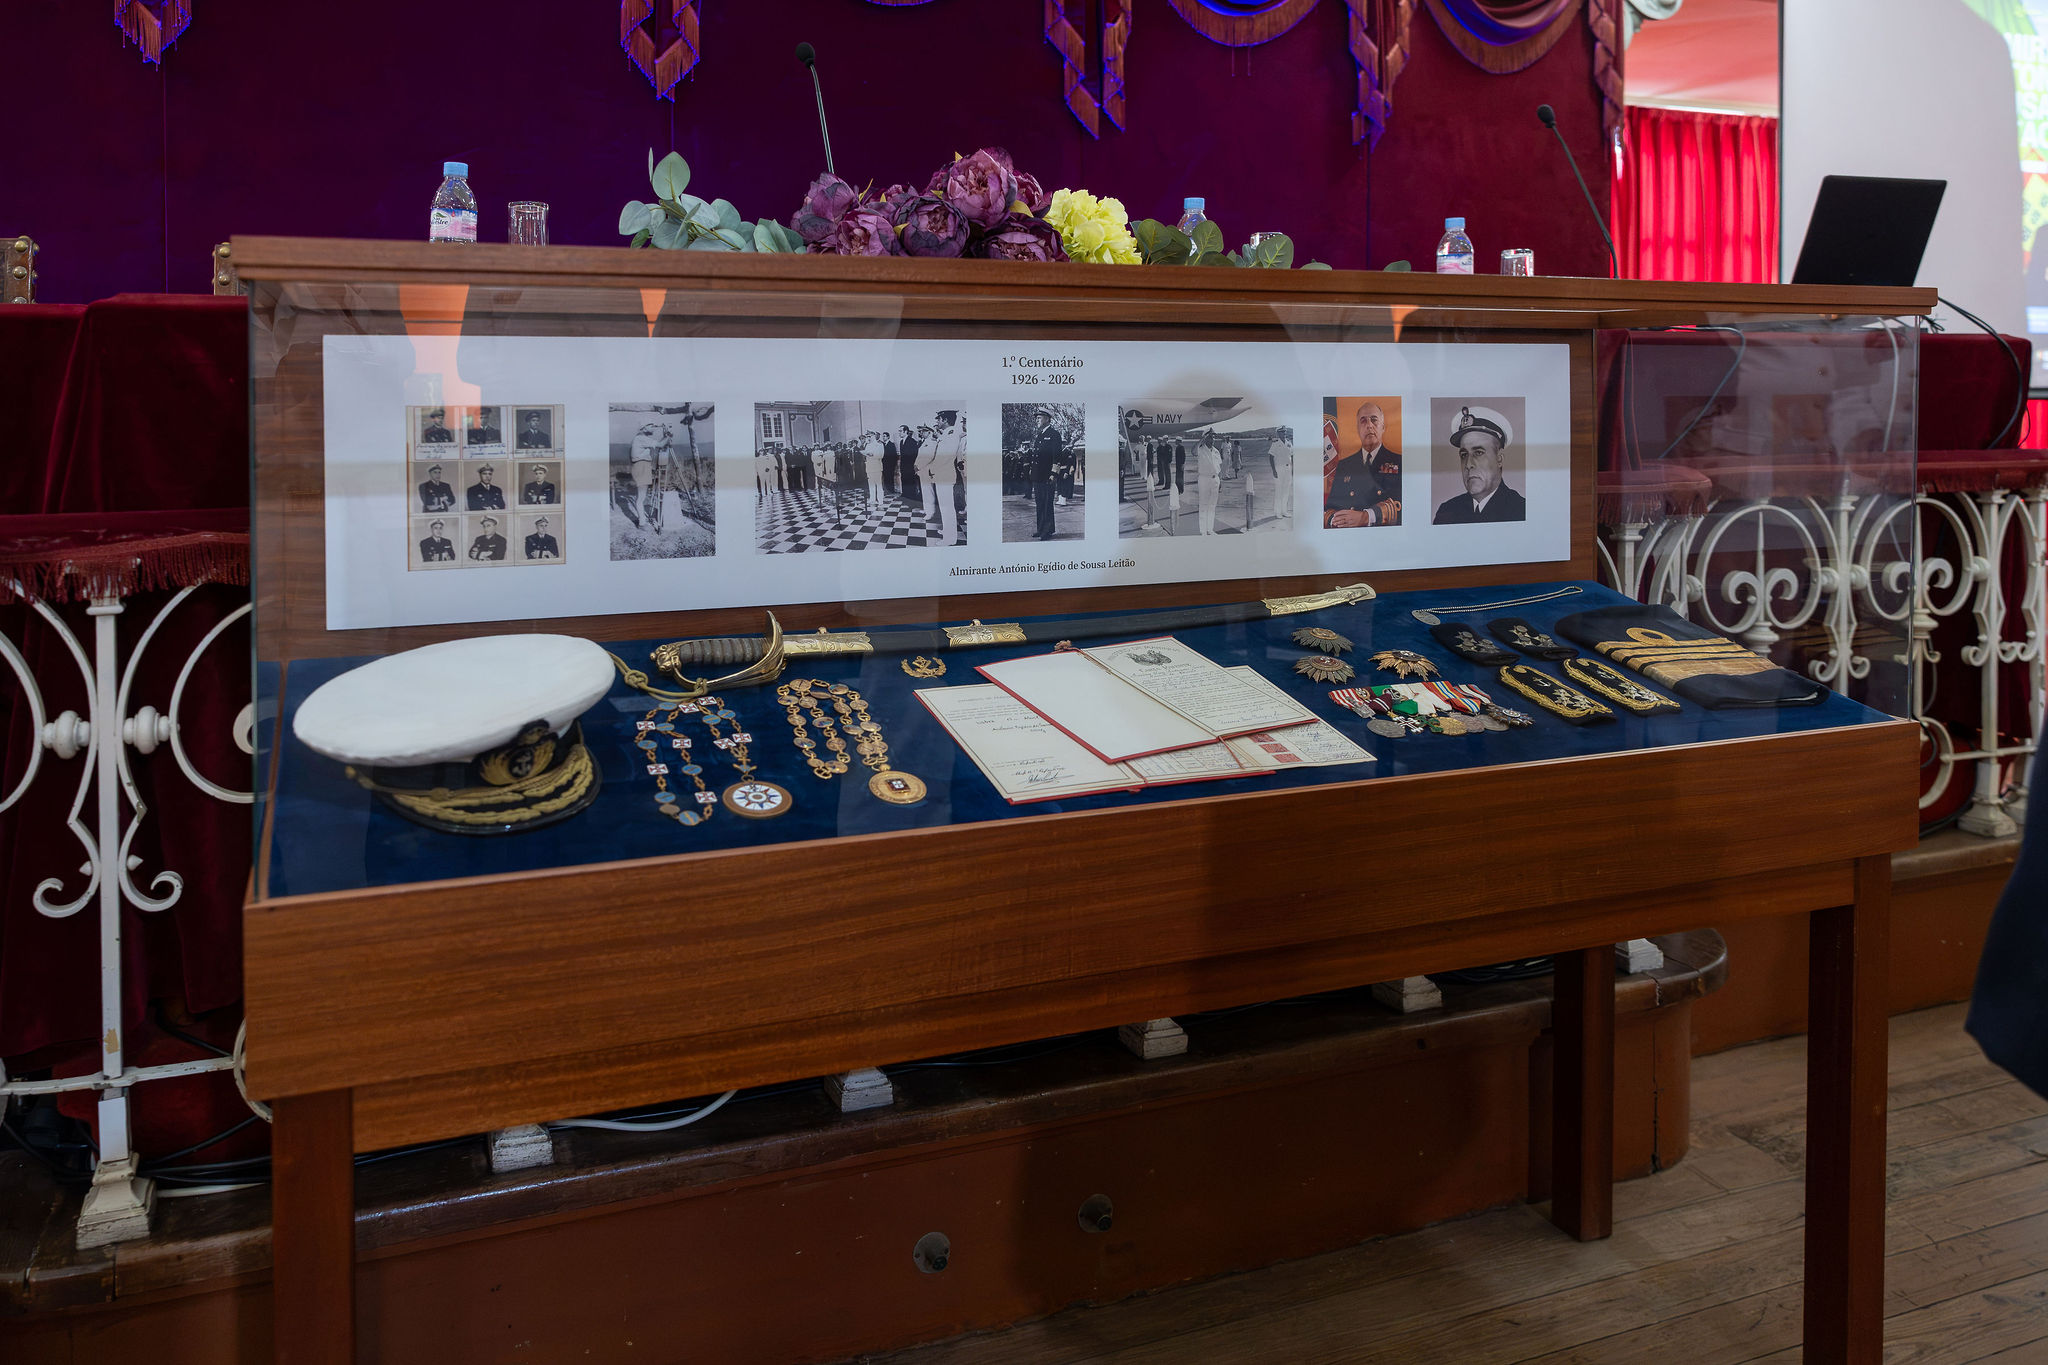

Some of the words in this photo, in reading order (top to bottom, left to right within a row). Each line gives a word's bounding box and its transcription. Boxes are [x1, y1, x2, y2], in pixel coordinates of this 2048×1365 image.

[1018, 356, 1084, 368] Centenário
[1011, 374, 1039, 385] 1926
[1048, 374, 1075, 385] 2026
[1156, 414, 1183, 423] NAVY
[949, 567, 997, 576] Almirante
[998, 563, 1036, 574] António
[1037, 562, 1066, 573] Egídio
[1067, 562, 1079, 570] de
[1080, 561, 1107, 569] Sousa
[1108, 558, 1136, 568] Leitão
